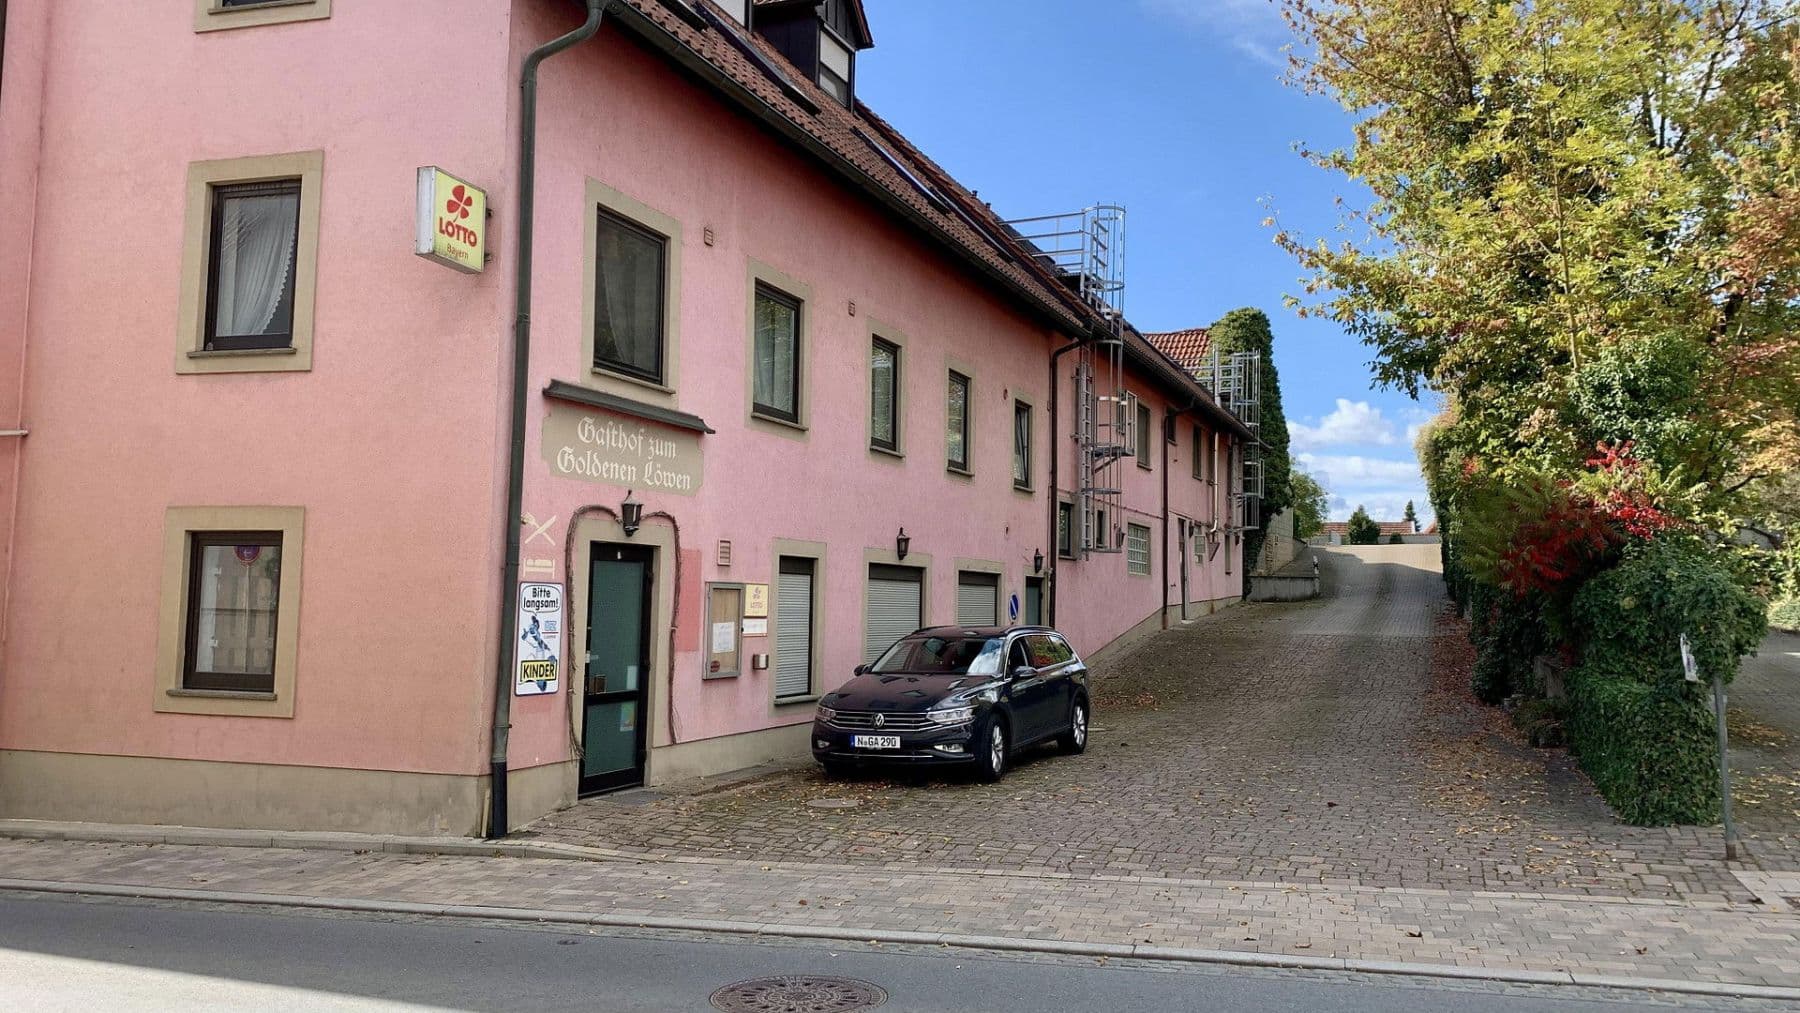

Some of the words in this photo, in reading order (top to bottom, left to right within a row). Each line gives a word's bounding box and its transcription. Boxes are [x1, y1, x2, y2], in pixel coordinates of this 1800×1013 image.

[439, 217, 477, 247] LOTTO
[446, 243, 469, 260] Bayern
[648, 437, 677, 460] zum
[557, 446, 637, 483] Goldenen
[643, 459, 691, 490] Löwen
[532, 588, 551, 598] Bitte
[523, 596, 559, 610] langsam!
[523, 663, 555, 679] KINDER
[880, 737, 896, 746] 290
